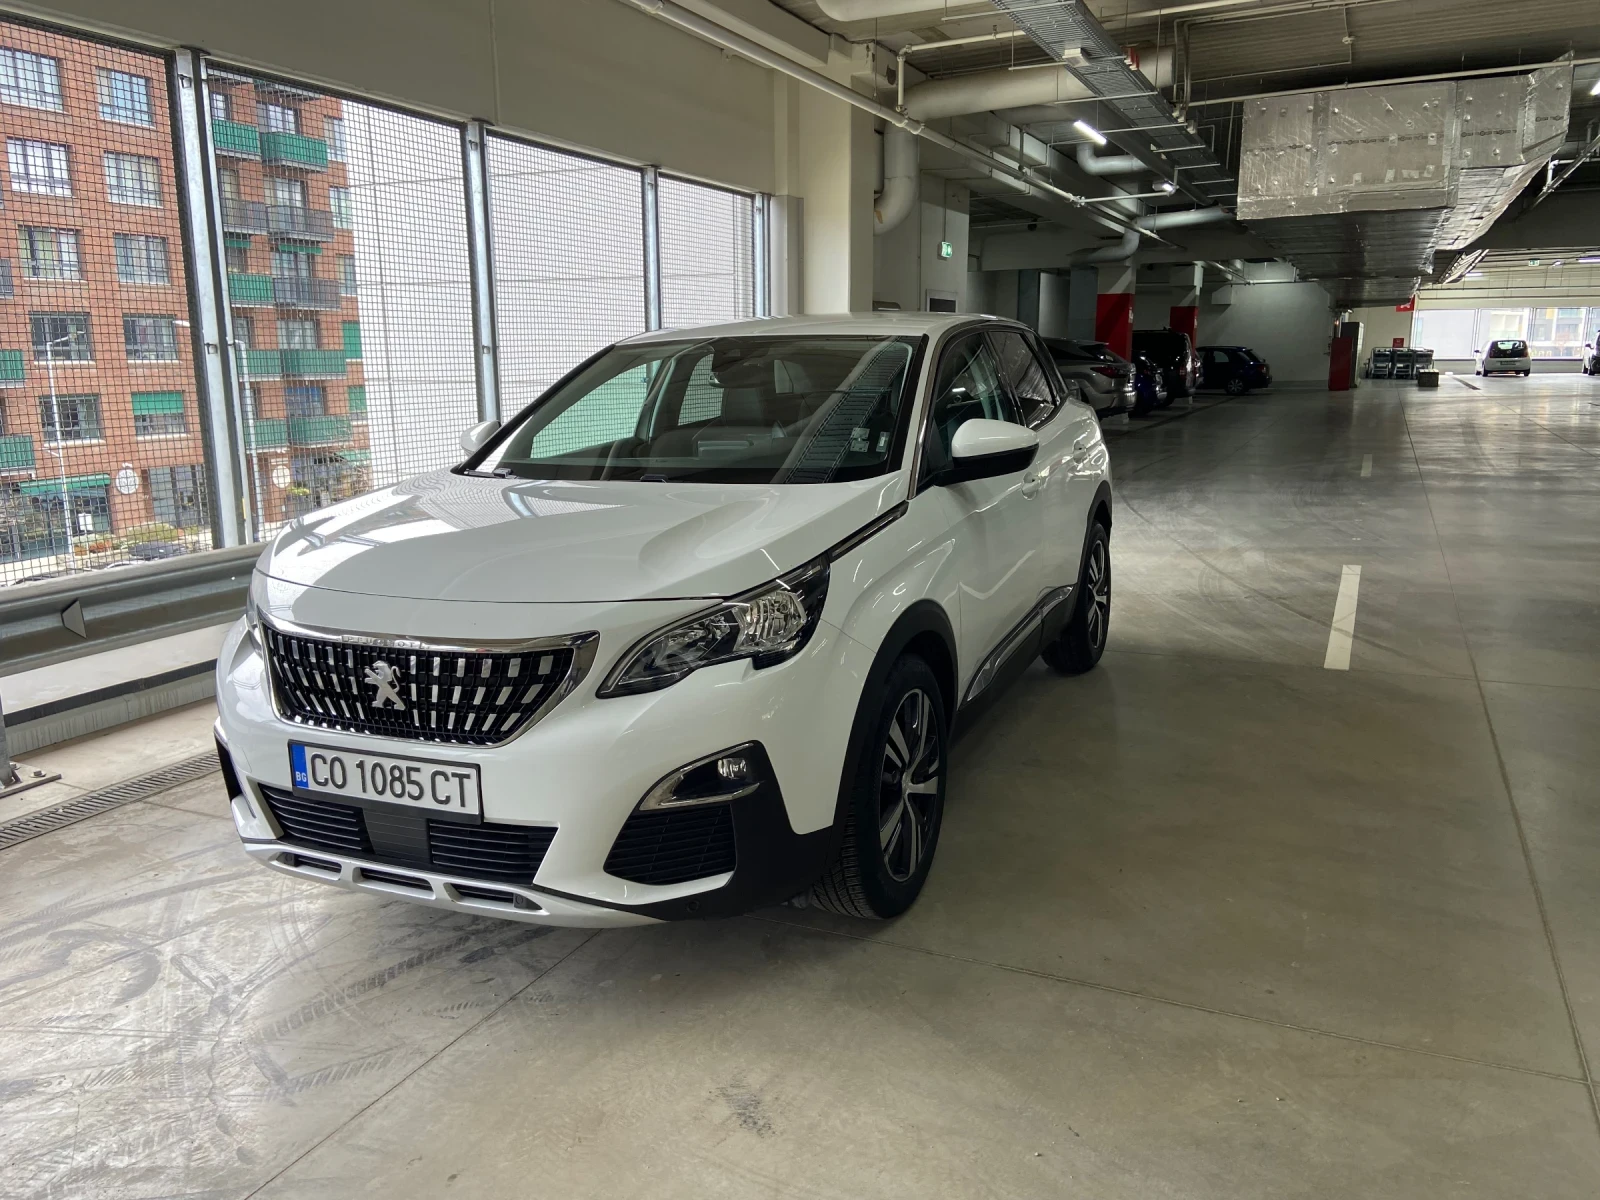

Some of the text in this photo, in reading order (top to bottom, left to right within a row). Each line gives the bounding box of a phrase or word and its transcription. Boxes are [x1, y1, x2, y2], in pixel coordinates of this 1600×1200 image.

[296, 771, 307, 783] BG
[310, 753, 471, 808] CO 1085 CT
